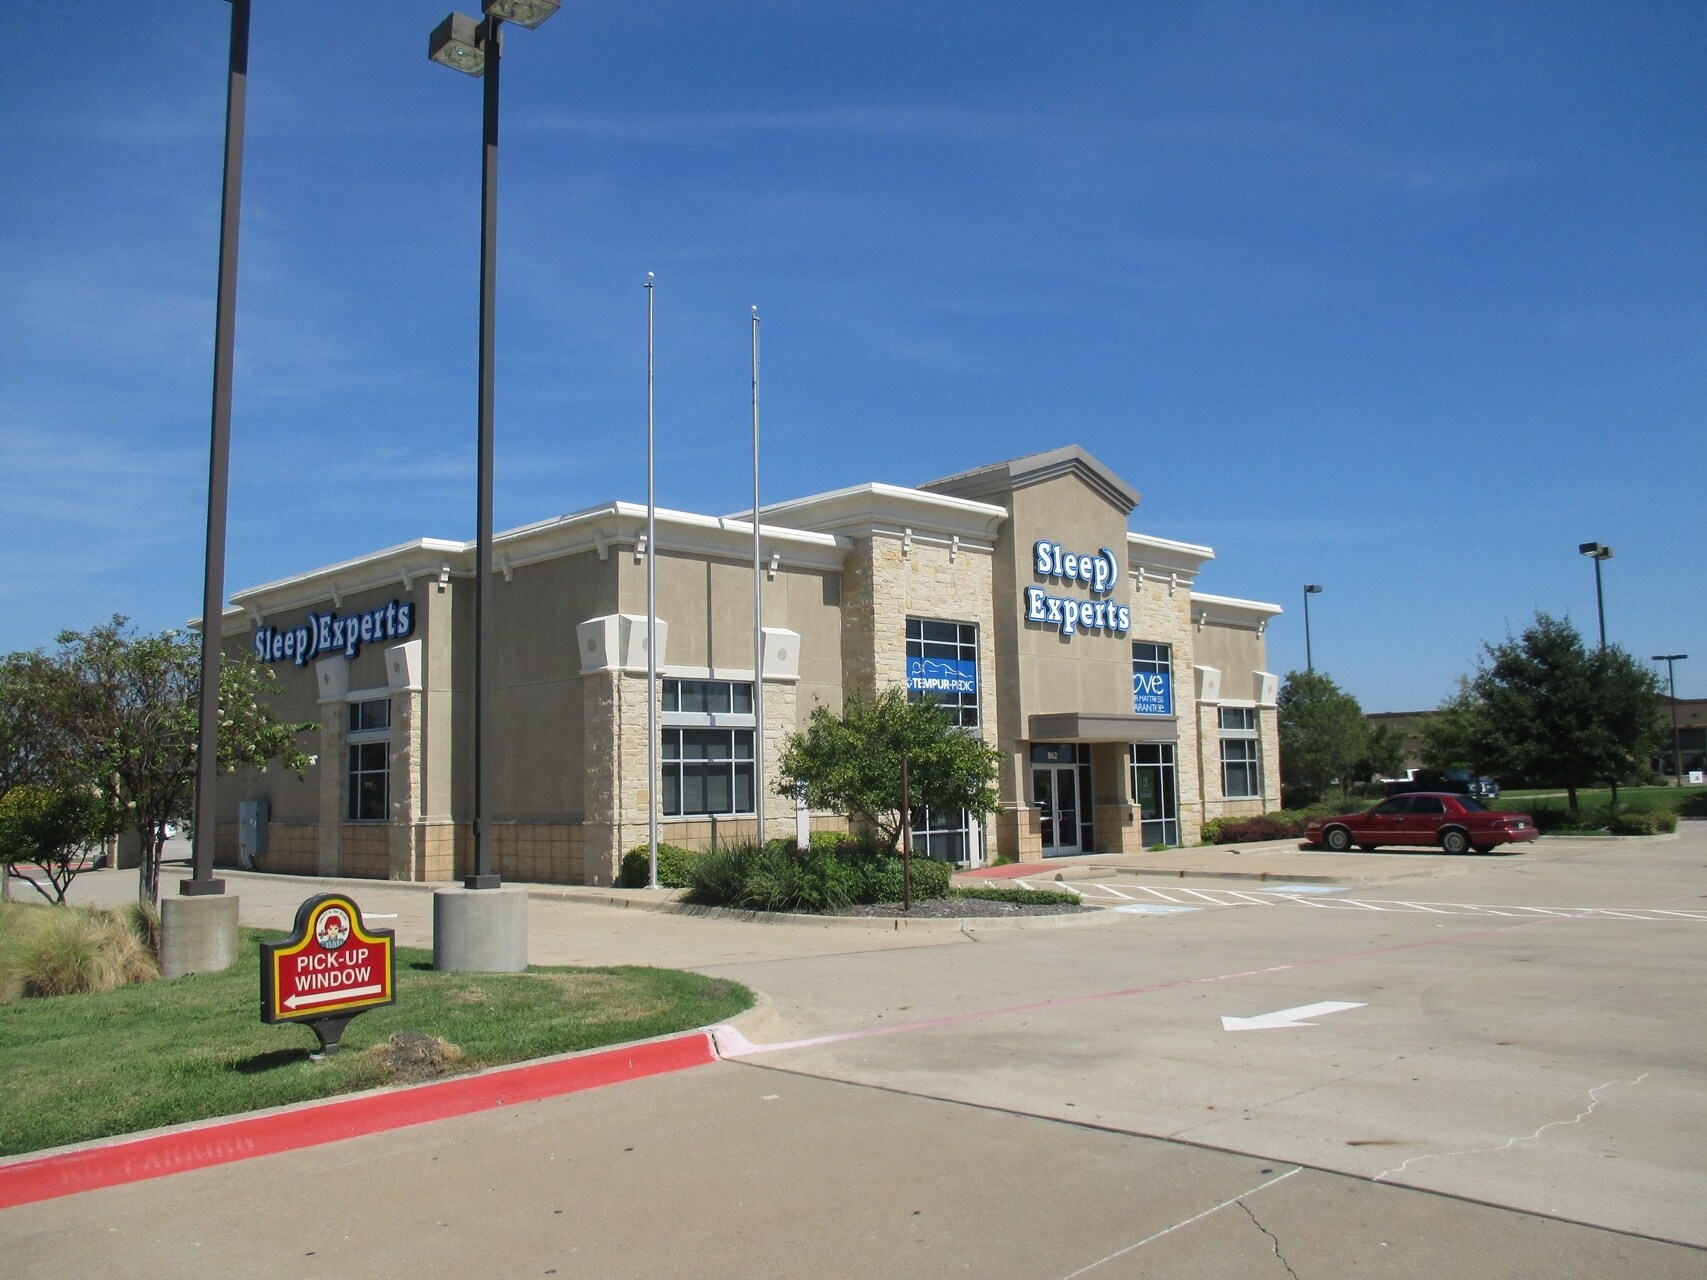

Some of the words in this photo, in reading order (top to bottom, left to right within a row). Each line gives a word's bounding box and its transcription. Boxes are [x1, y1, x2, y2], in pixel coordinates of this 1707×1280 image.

[1037, 541, 1109, 592] Sleep
[1028, 586, 1130, 635] Experts
[255, 627, 307, 667] Sleep
[318, 602, 411, 657] Experts
[1047, 751, 1058, 760] 862
[295, 966, 371, 992] WINDOW
[297, 948, 369, 973] PICK-UP
